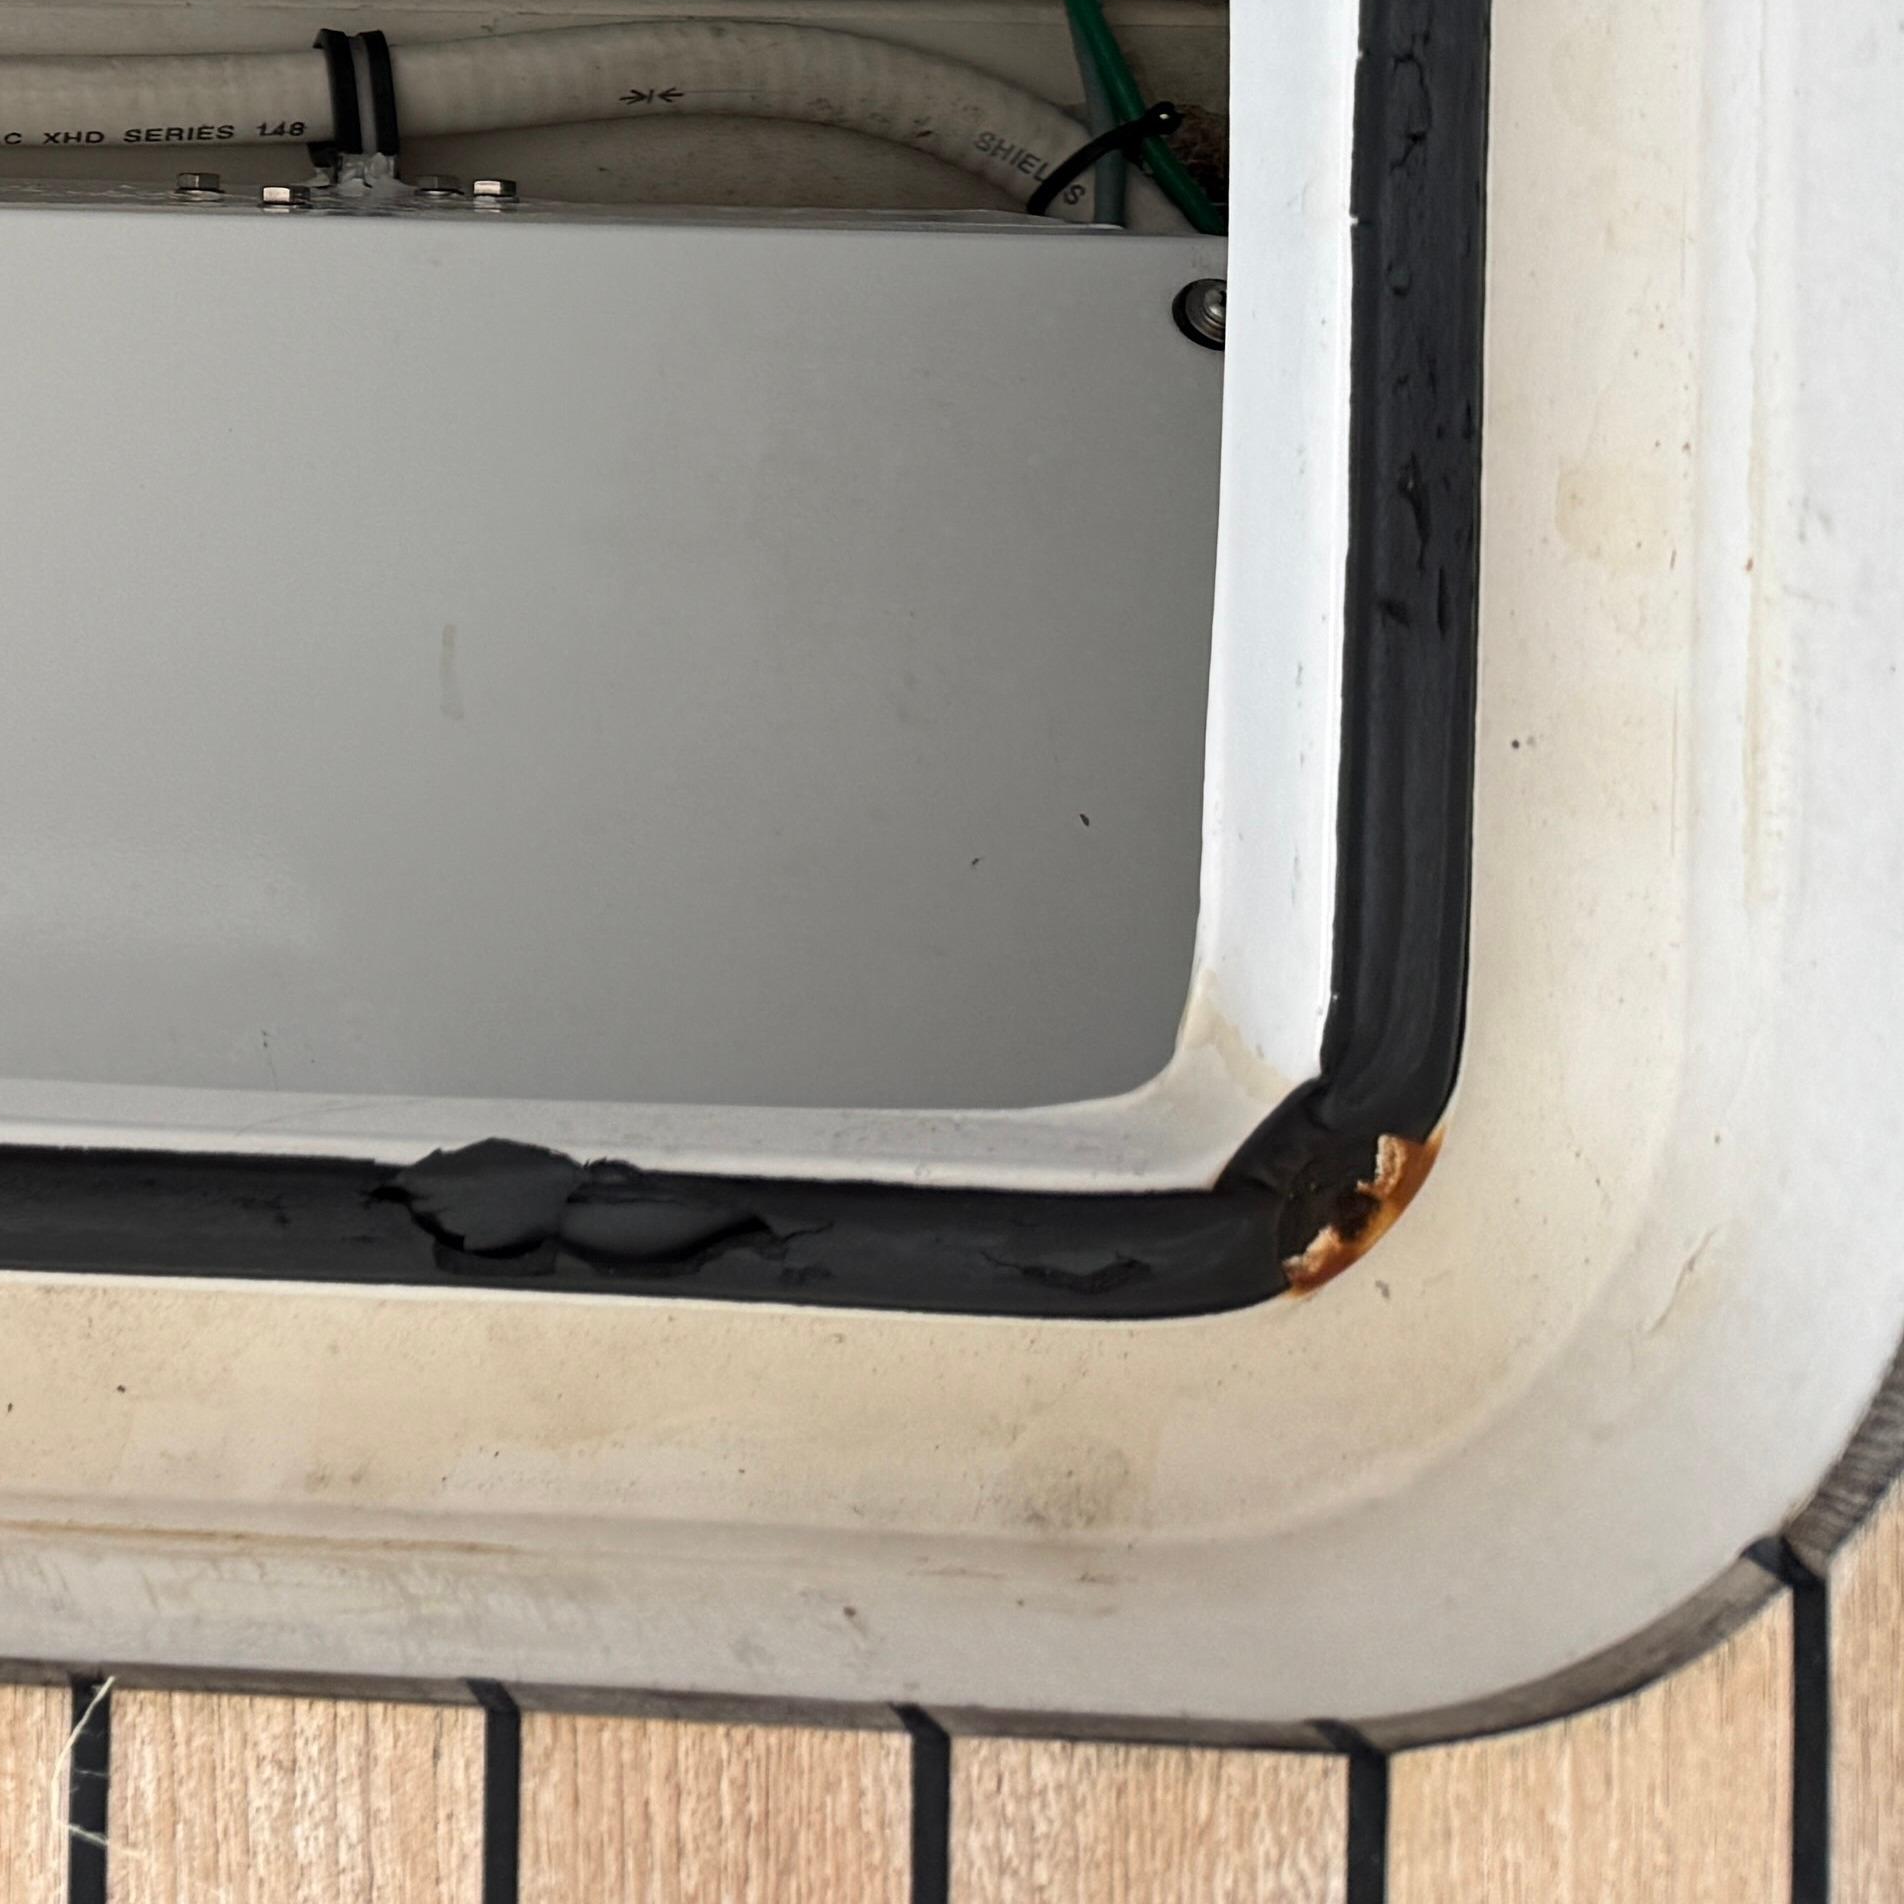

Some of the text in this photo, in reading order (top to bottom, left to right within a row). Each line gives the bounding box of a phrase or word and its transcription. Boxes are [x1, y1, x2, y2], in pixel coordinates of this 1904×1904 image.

[43, 130, 105, 146] XHD
[122, 124, 236, 144] SERIES
[973, 130, 1087, 206] SHIELS
